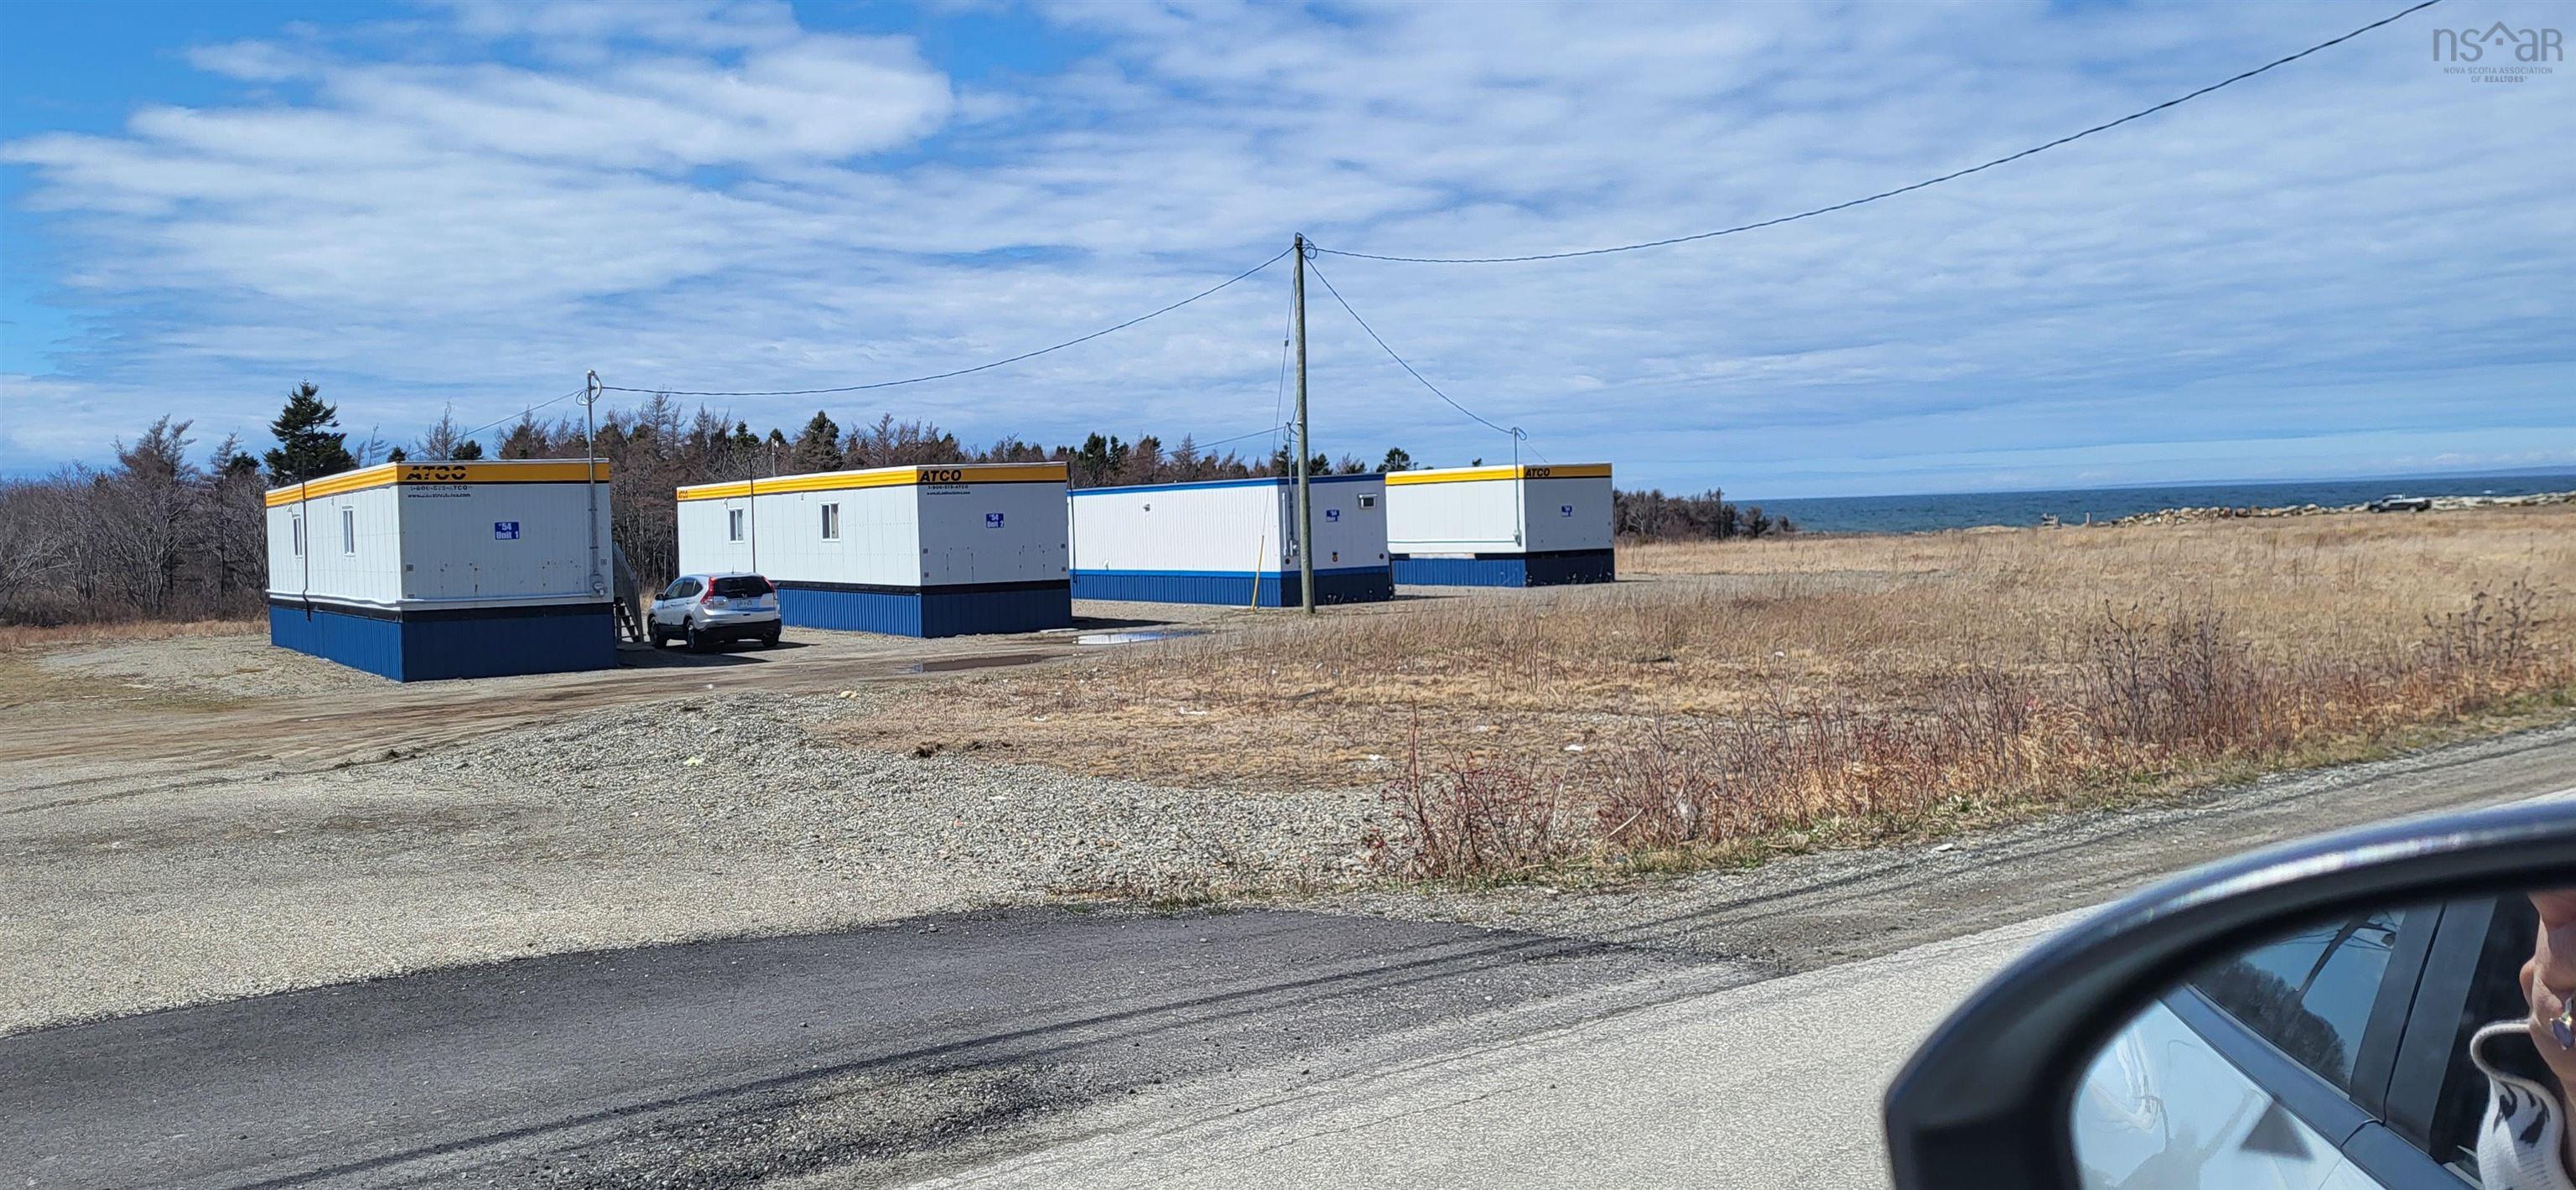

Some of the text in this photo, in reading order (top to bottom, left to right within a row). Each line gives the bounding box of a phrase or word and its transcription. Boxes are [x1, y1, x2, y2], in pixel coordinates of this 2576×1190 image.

[406, 465, 466, 481] ATCO
[920, 470, 962, 482] ATCO
[1526, 468, 1550, 477] ATCO
